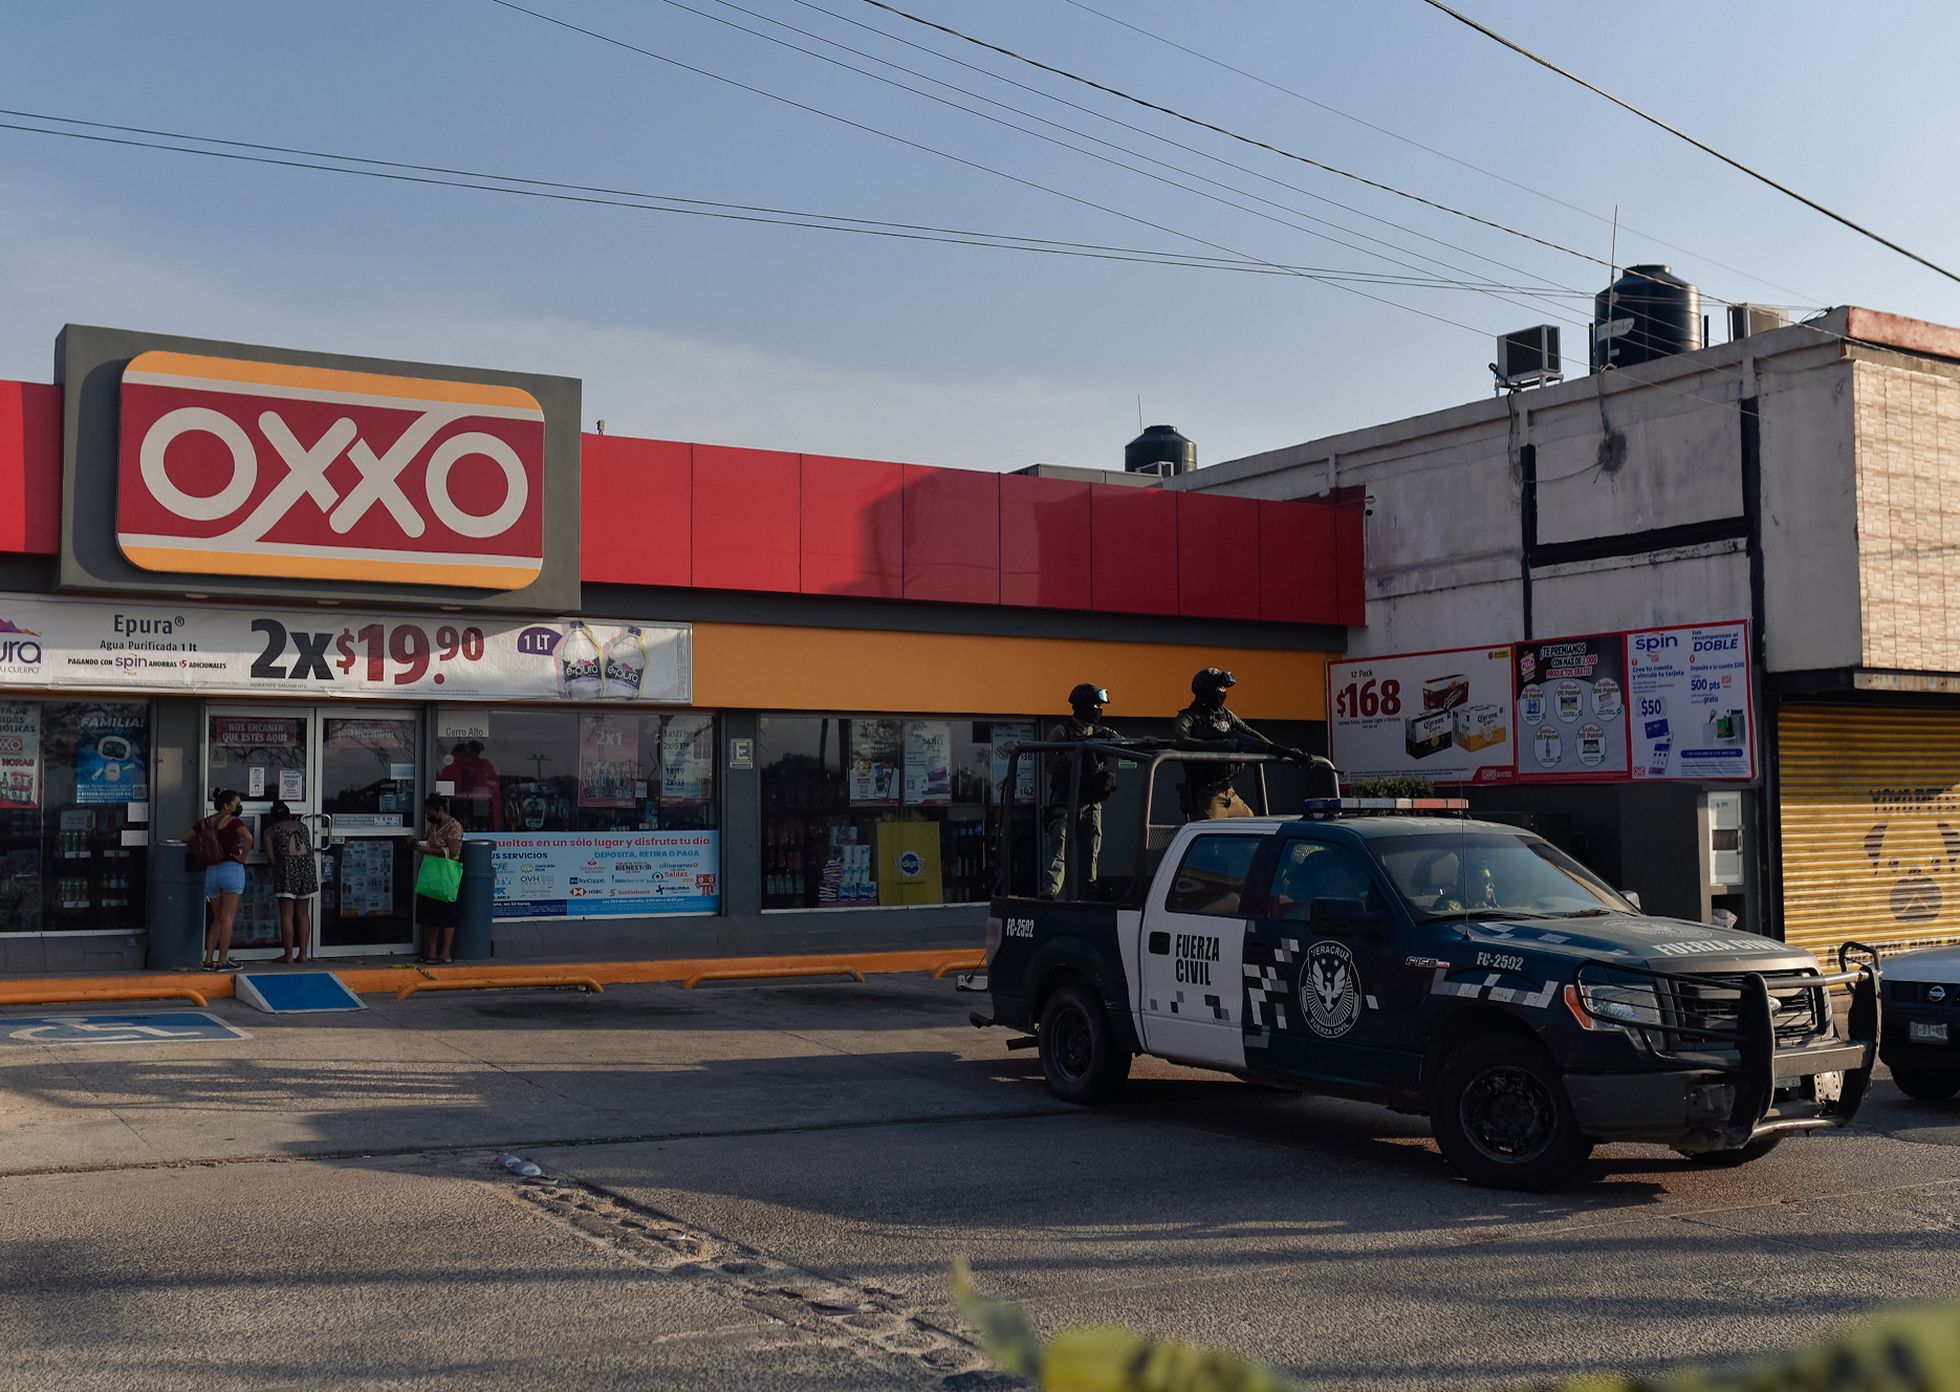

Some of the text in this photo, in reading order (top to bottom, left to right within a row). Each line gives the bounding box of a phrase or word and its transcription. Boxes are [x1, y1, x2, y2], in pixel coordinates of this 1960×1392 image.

[139, 406, 528, 540] OXXO
[100, 640, 124, 652] Agua
[128, 640, 178, 652] Purificada
[180, 643, 186, 651] 1
[524, 634, 550, 650] 1 LT
[1635, 634, 1678, 652] spin
[1694, 639, 1738, 652] DOBLE
[1550, 644, 1586, 656] PREMIAMOS
[67, 658, 98, 666] PAGANDO
[114, 654, 148, 670] spin
[148, 660, 177, 668] AHORRAS
[179, 660, 188, 668] $5
[188, 661, 226, 669] ADICIONALES
[1552, 658, 1562, 666] CON
[1359, 668, 1374, 678] Pack
[1666, 670, 1684, 678] tarjeta
[1691, 679, 1720, 691] 500 pts
[1336, 678, 1401, 718] $168
[16, 706, 28, 715] DE
[1641, 698, 1661, 717] $50
[1424, 717, 1444, 730] Corona
[1478, 712, 1498, 723] Corona
[229, 723, 245, 732] NOS
[446, 728, 484, 736] Cerro Alto
[222, 732, 238, 742] QUE
[496, 838, 534, 848] ueltas
[570, 838, 592, 847] sólo
[594, 837, 624, 849] lugar
[626, 838, 632, 849] y
[635, 836, 678, 846] disfruta
[680, 836, 691, 846] tu
[692, 836, 710, 845] día
[503, 852, 548, 860] SERVICIOS
[594, 850, 637, 858] DEPOSITA,
[639, 850, 667, 858] RETIRA
[1176, 934, 1220, 962] FUERZA
[1310, 945, 1351, 962] VERACRUZ
[1652, 939, 1789, 956] FUERZA CIVIL
[1476, 952, 1524, 971] FC-2592
[1176, 958, 1211, 986] CIVIL
[1310, 1018, 1350, 1036] FUERZA CIVIL
